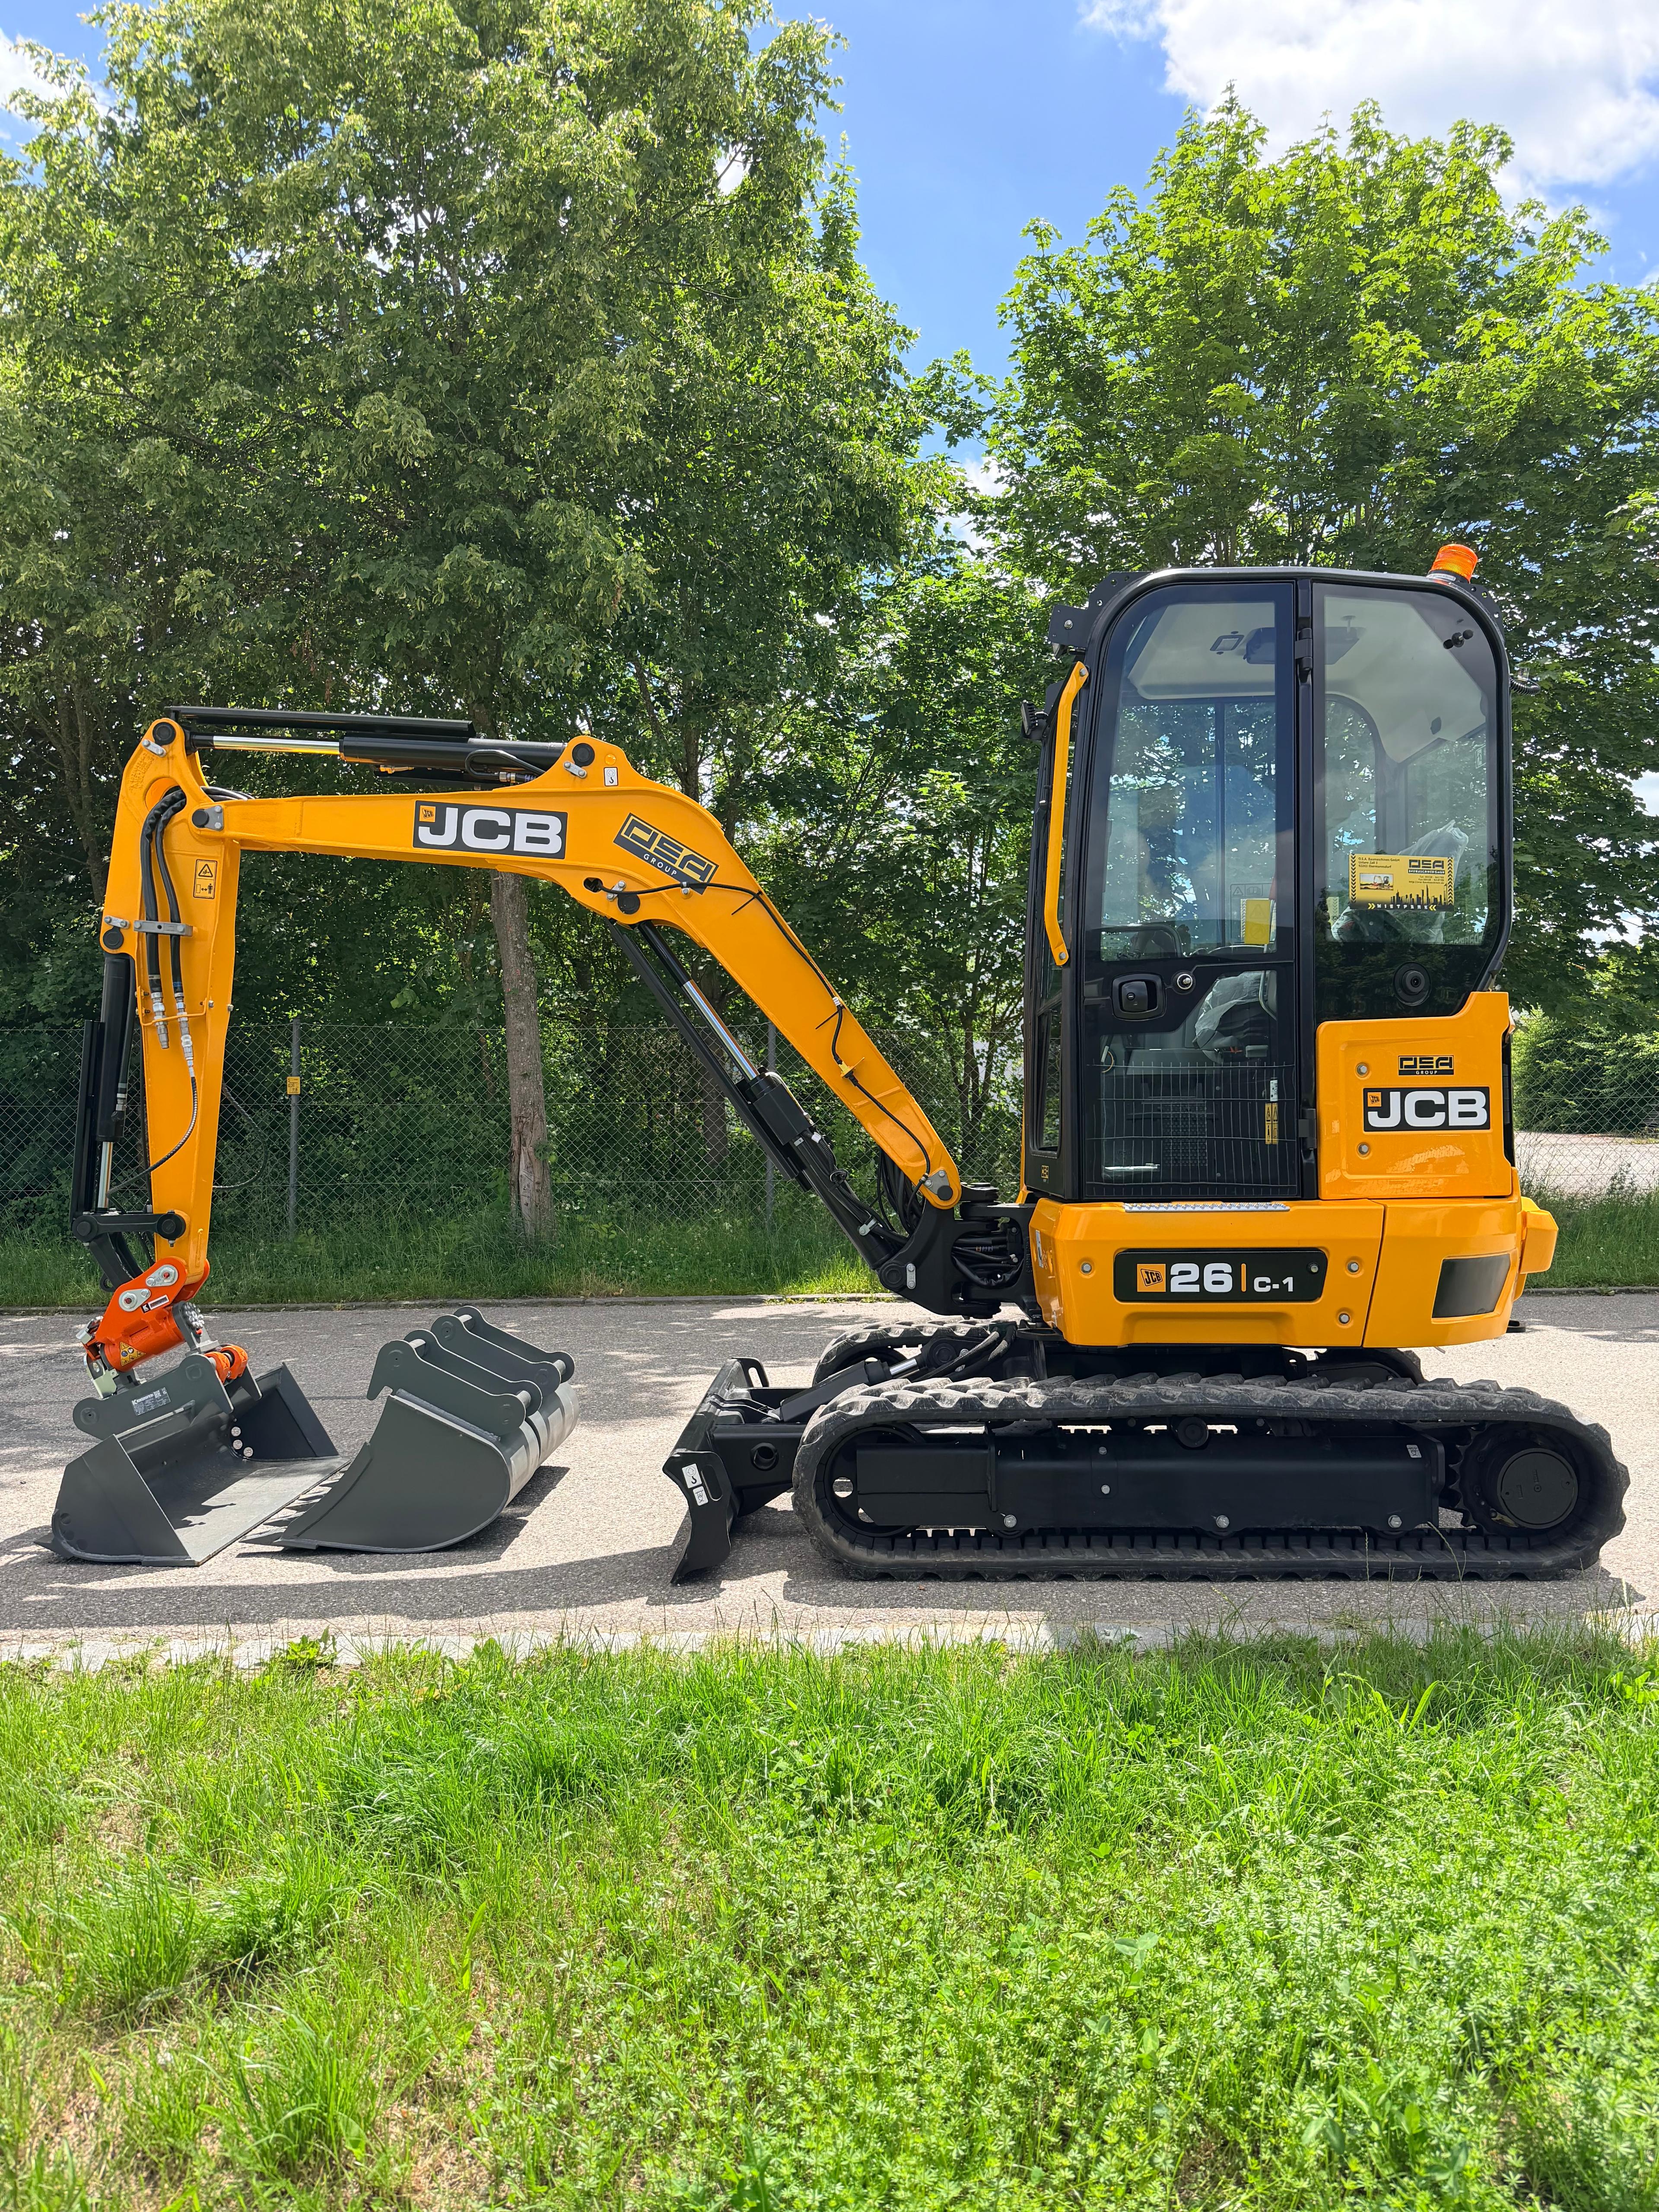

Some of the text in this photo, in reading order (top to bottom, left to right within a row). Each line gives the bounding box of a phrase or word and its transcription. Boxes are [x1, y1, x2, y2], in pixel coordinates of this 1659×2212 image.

[424, 809, 433, 817] JCB
[418, 807, 563, 854] JCB
[643, 853, 677, 876] GROUP
[1367, 1090, 1487, 1128] JCB
[1145, 1271, 1161, 1284] JCB
[1170, 1263, 1294, 1293] 26 C-1
